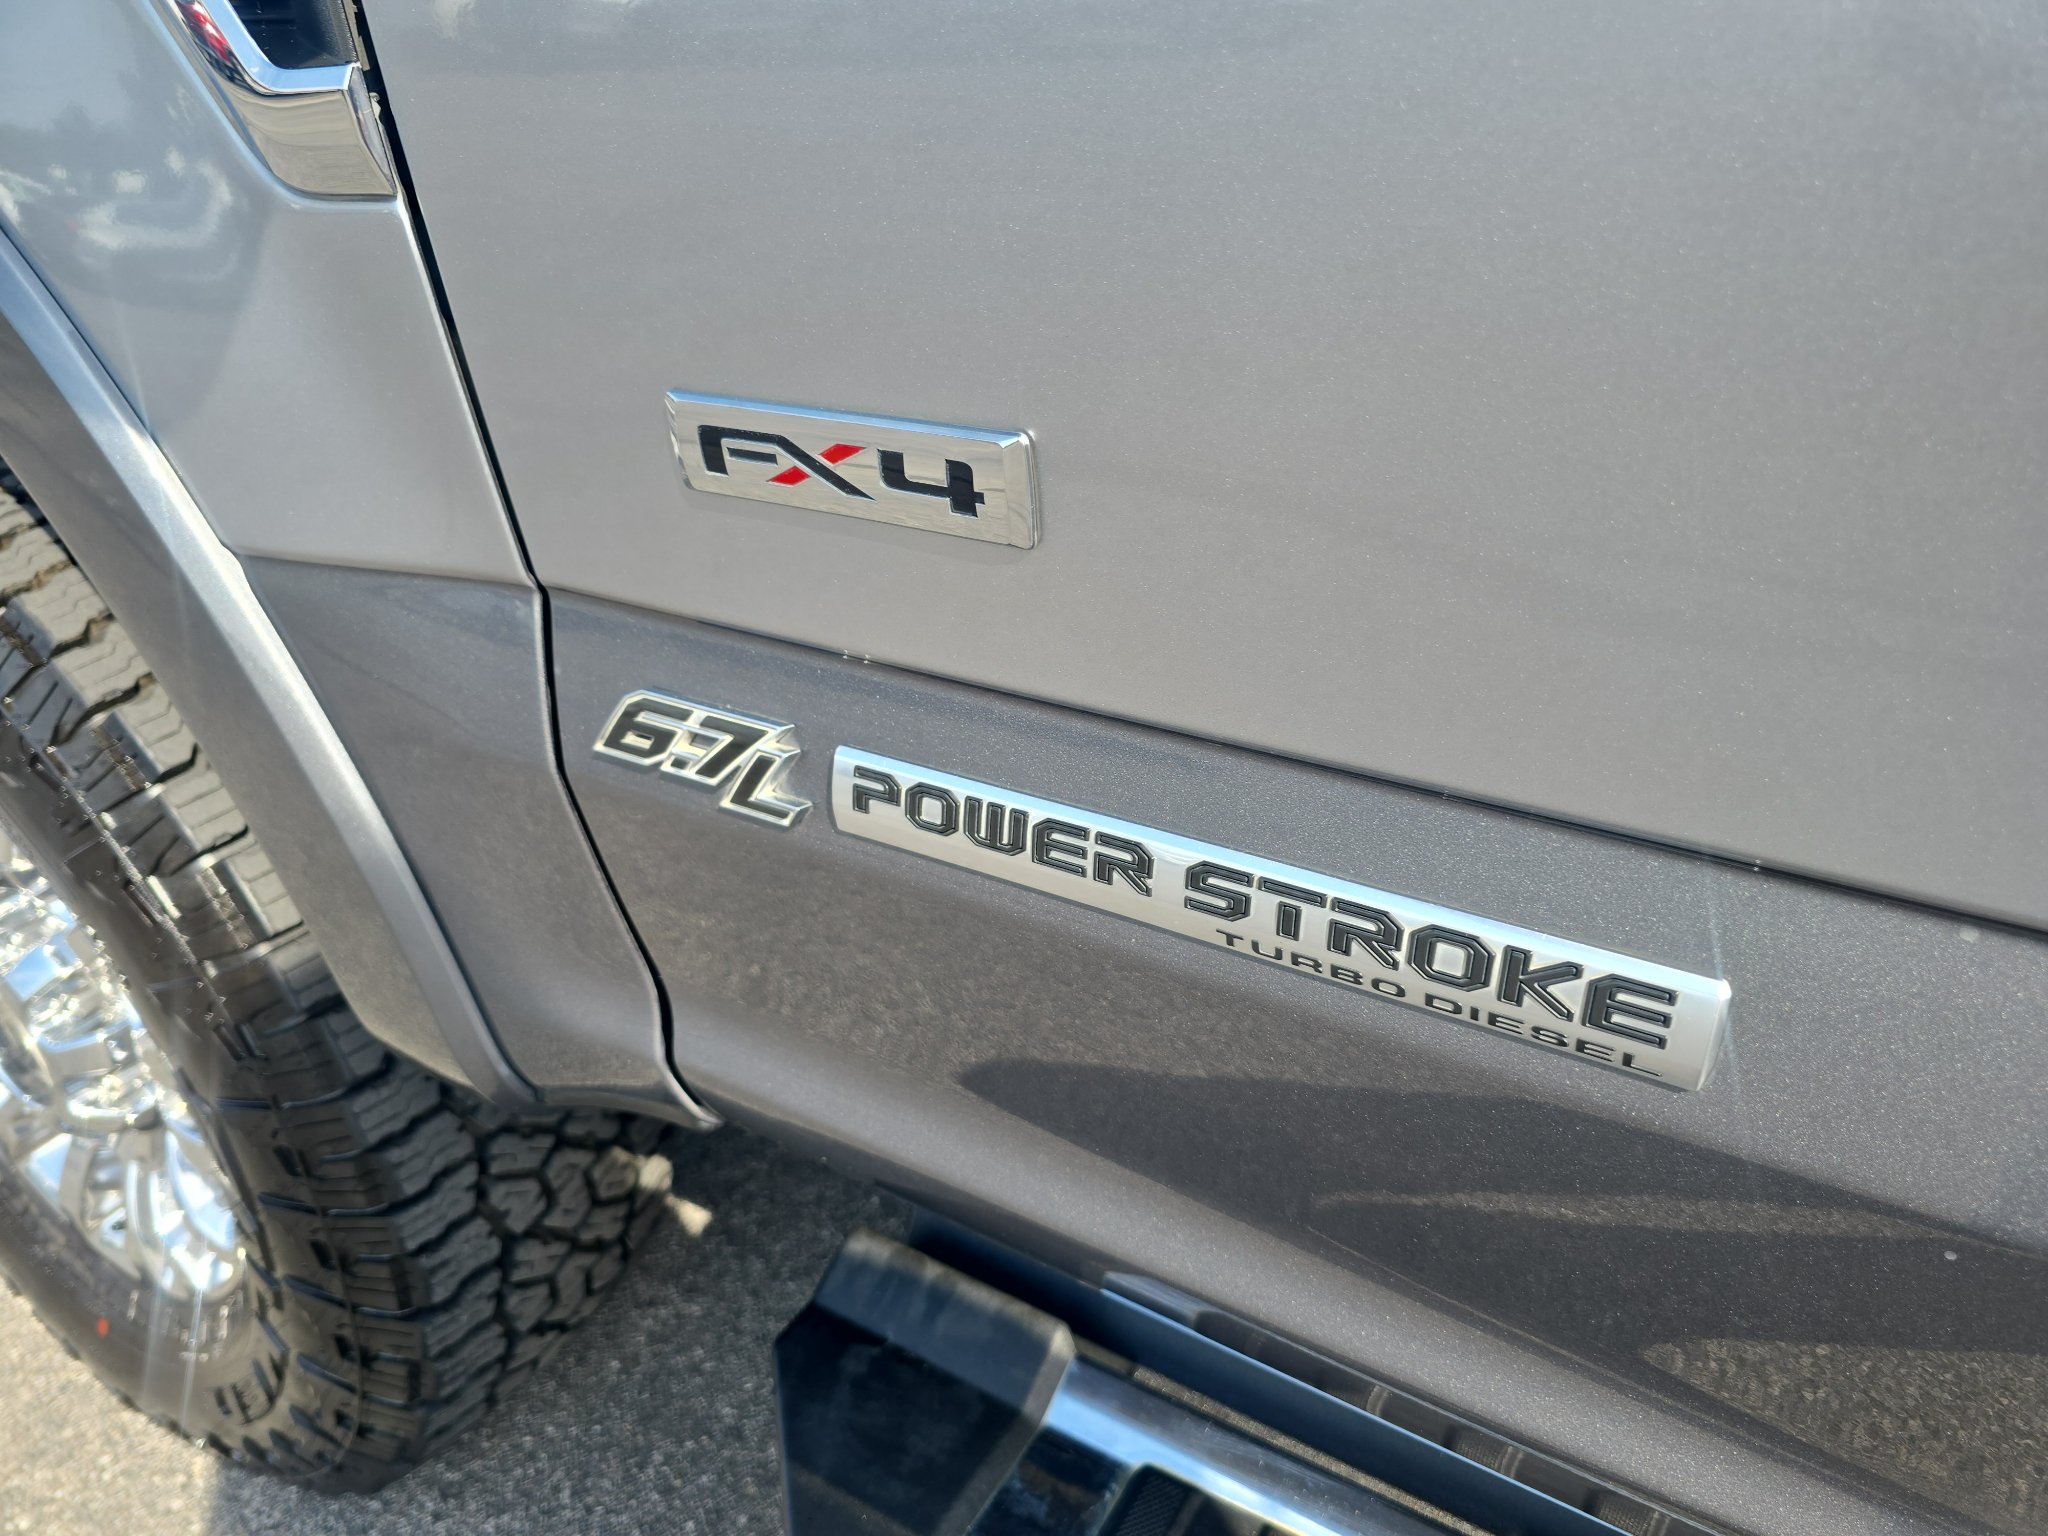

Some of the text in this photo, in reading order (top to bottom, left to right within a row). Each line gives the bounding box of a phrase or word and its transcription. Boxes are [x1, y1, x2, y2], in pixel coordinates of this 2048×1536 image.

[697, 425, 986, 518] FX4
[595, 691, 811, 827] 6.7L
[852, 765, 1679, 1050] POWER STROKE
[1216, 928, 1662, 1077] TURBO DIESEL
